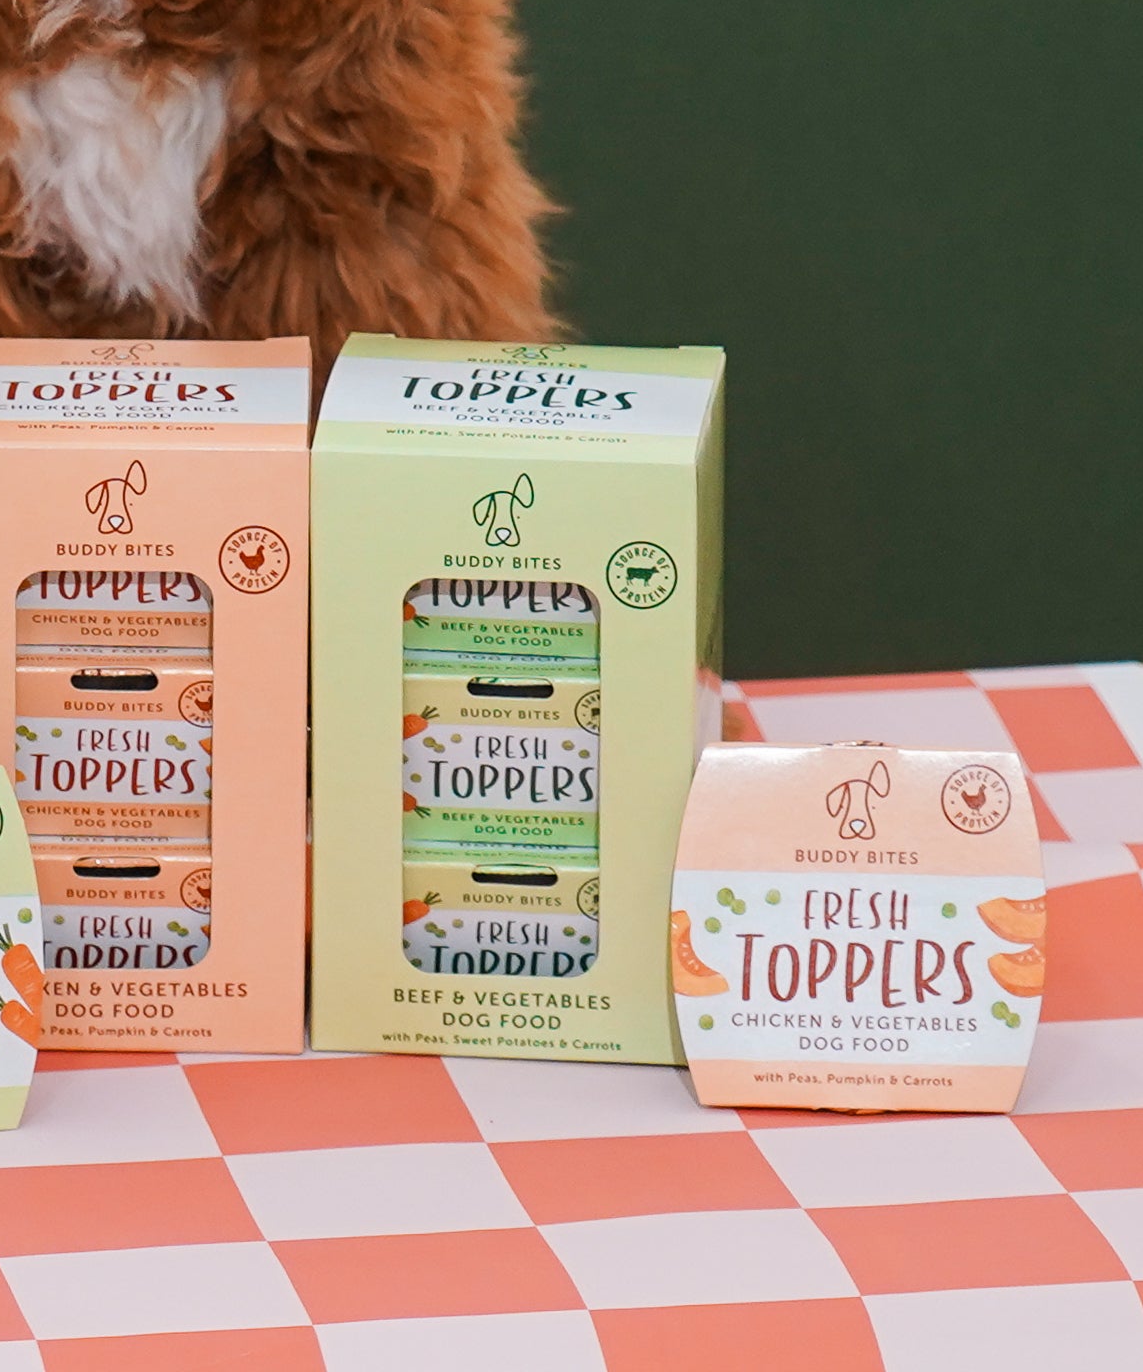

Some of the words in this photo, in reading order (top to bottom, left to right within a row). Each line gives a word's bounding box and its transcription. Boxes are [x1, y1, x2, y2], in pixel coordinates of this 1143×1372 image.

[69, 370, 172, 381] FRESH
[471, 368, 576, 386] FRESH
[1, 381, 238, 403] TOPPERS
[402, 376, 638, 411] TOPPERS
[115, 405, 240, 413] VEGETABLES
[412, 404, 459, 412] BEEF
[487, 407, 612, 420] VEGETABLES
[455, 414, 500, 423] DOG
[508, 417, 566, 426] FOOD
[56, 544, 118, 556] BUDDY
[126, 544, 175, 557] BITES
[227, 532, 268, 553] SOURCE
[269, 541, 282, 554] OF
[444, 555, 505, 569] BUDDY
[512, 557, 562, 571] BITES
[615, 547, 655, 568] SOURCE
[656, 556, 671, 570] OF
[231, 569, 279, 588] PROTEIN
[619, 585, 667, 603] PROTEIN
[31, 614, 97, 624] CHICKEN
[103, 615, 112, 624] &
[117, 615, 207, 627] VEGETABLES
[80, 627, 113, 637] DOG
[118, 628, 160, 637] FOOD
[441, 622, 474, 632] BEEF
[479, 623, 488, 632] &
[493, 624, 584, 637] VEGETABLES
[473, 635, 506, 645] DOG
[511, 637, 552, 647] FOOD
[64, 700, 115, 712] BUDDY
[122, 702, 163, 713] BITES
[460, 708, 512, 719] BUDDY
[518, 710, 560, 721] BITES
[77, 728, 150, 752] FRESH
[475, 735, 547, 759] FRESH
[29, 753, 198, 795] TOPPERS
[428, 760, 595, 803] TOPPERS
[950, 771, 988, 792] SOURCE
[990, 781, 1003, 794] OF
[26, 805, 91, 816] CHICKEN
[97, 807, 105, 816] &
[110, 808, 200, 818] VEGETABLES
[442, 812, 474, 821] BEEF
[481, 814, 490, 822] &
[495, 815, 585, 826] VEGETABLES
[954, 810, 1001, 829] PROTEIN
[74, 819, 106, 828] DOG
[112, 819, 153, 829] FOOD
[474, 825, 507, 834] DOG
[512, 827, 553, 836] FOOD
[795, 849, 859, 864] BUDDY
[867, 850, 919, 865] BITES
[66, 888, 117, 899] BUDDY
[124, 890, 166, 900] BITES
[463, 894, 514, 904] BUDDY
[520, 896, 562, 907] BITES
[804, 887, 909, 931] FRESH
[79, 915, 152, 939] FRESH
[476, 920, 549, 946] FRESH
[736, 934, 976, 1009] TOPPERS
[89, 982, 102, 996] &
[111, 982, 248, 997] VEGETABLES
[394, 988, 443, 1004] BEEF
[453, 991, 465, 1004] &
[474, 992, 611, 1010] VEGETABLES
[56, 1003, 104, 1018] DOG
[113, 1004, 174, 1018] FOOD
[442, 1012, 491, 1028] DOG
[500, 1014, 562, 1030] FOOD
[731, 1012, 822, 1028] CHICKEN
[831, 1015, 842, 1028] &
[851, 1015, 978, 1032] VEGETABLES
[88, 1026, 146, 1037] Pumpkin
[150, 1027, 158, 1036] &
[163, 1027, 212, 1037] Carrots
[382, 1032, 410, 1042] with
[453, 1035, 492, 1046] Sweet
[497, 1037, 554, 1049] Potatoes
[559, 1039, 568, 1049] &
[572, 1039, 622, 1051] Carrots
[799, 1036, 844, 1051] DOG
[853, 1038, 910, 1052] FOOD
[753, 1072, 783, 1083] with
[827, 1073, 885, 1086] Pumpkin
[890, 1075, 898, 1085] &
[903, 1075, 953, 1087] Carrots
